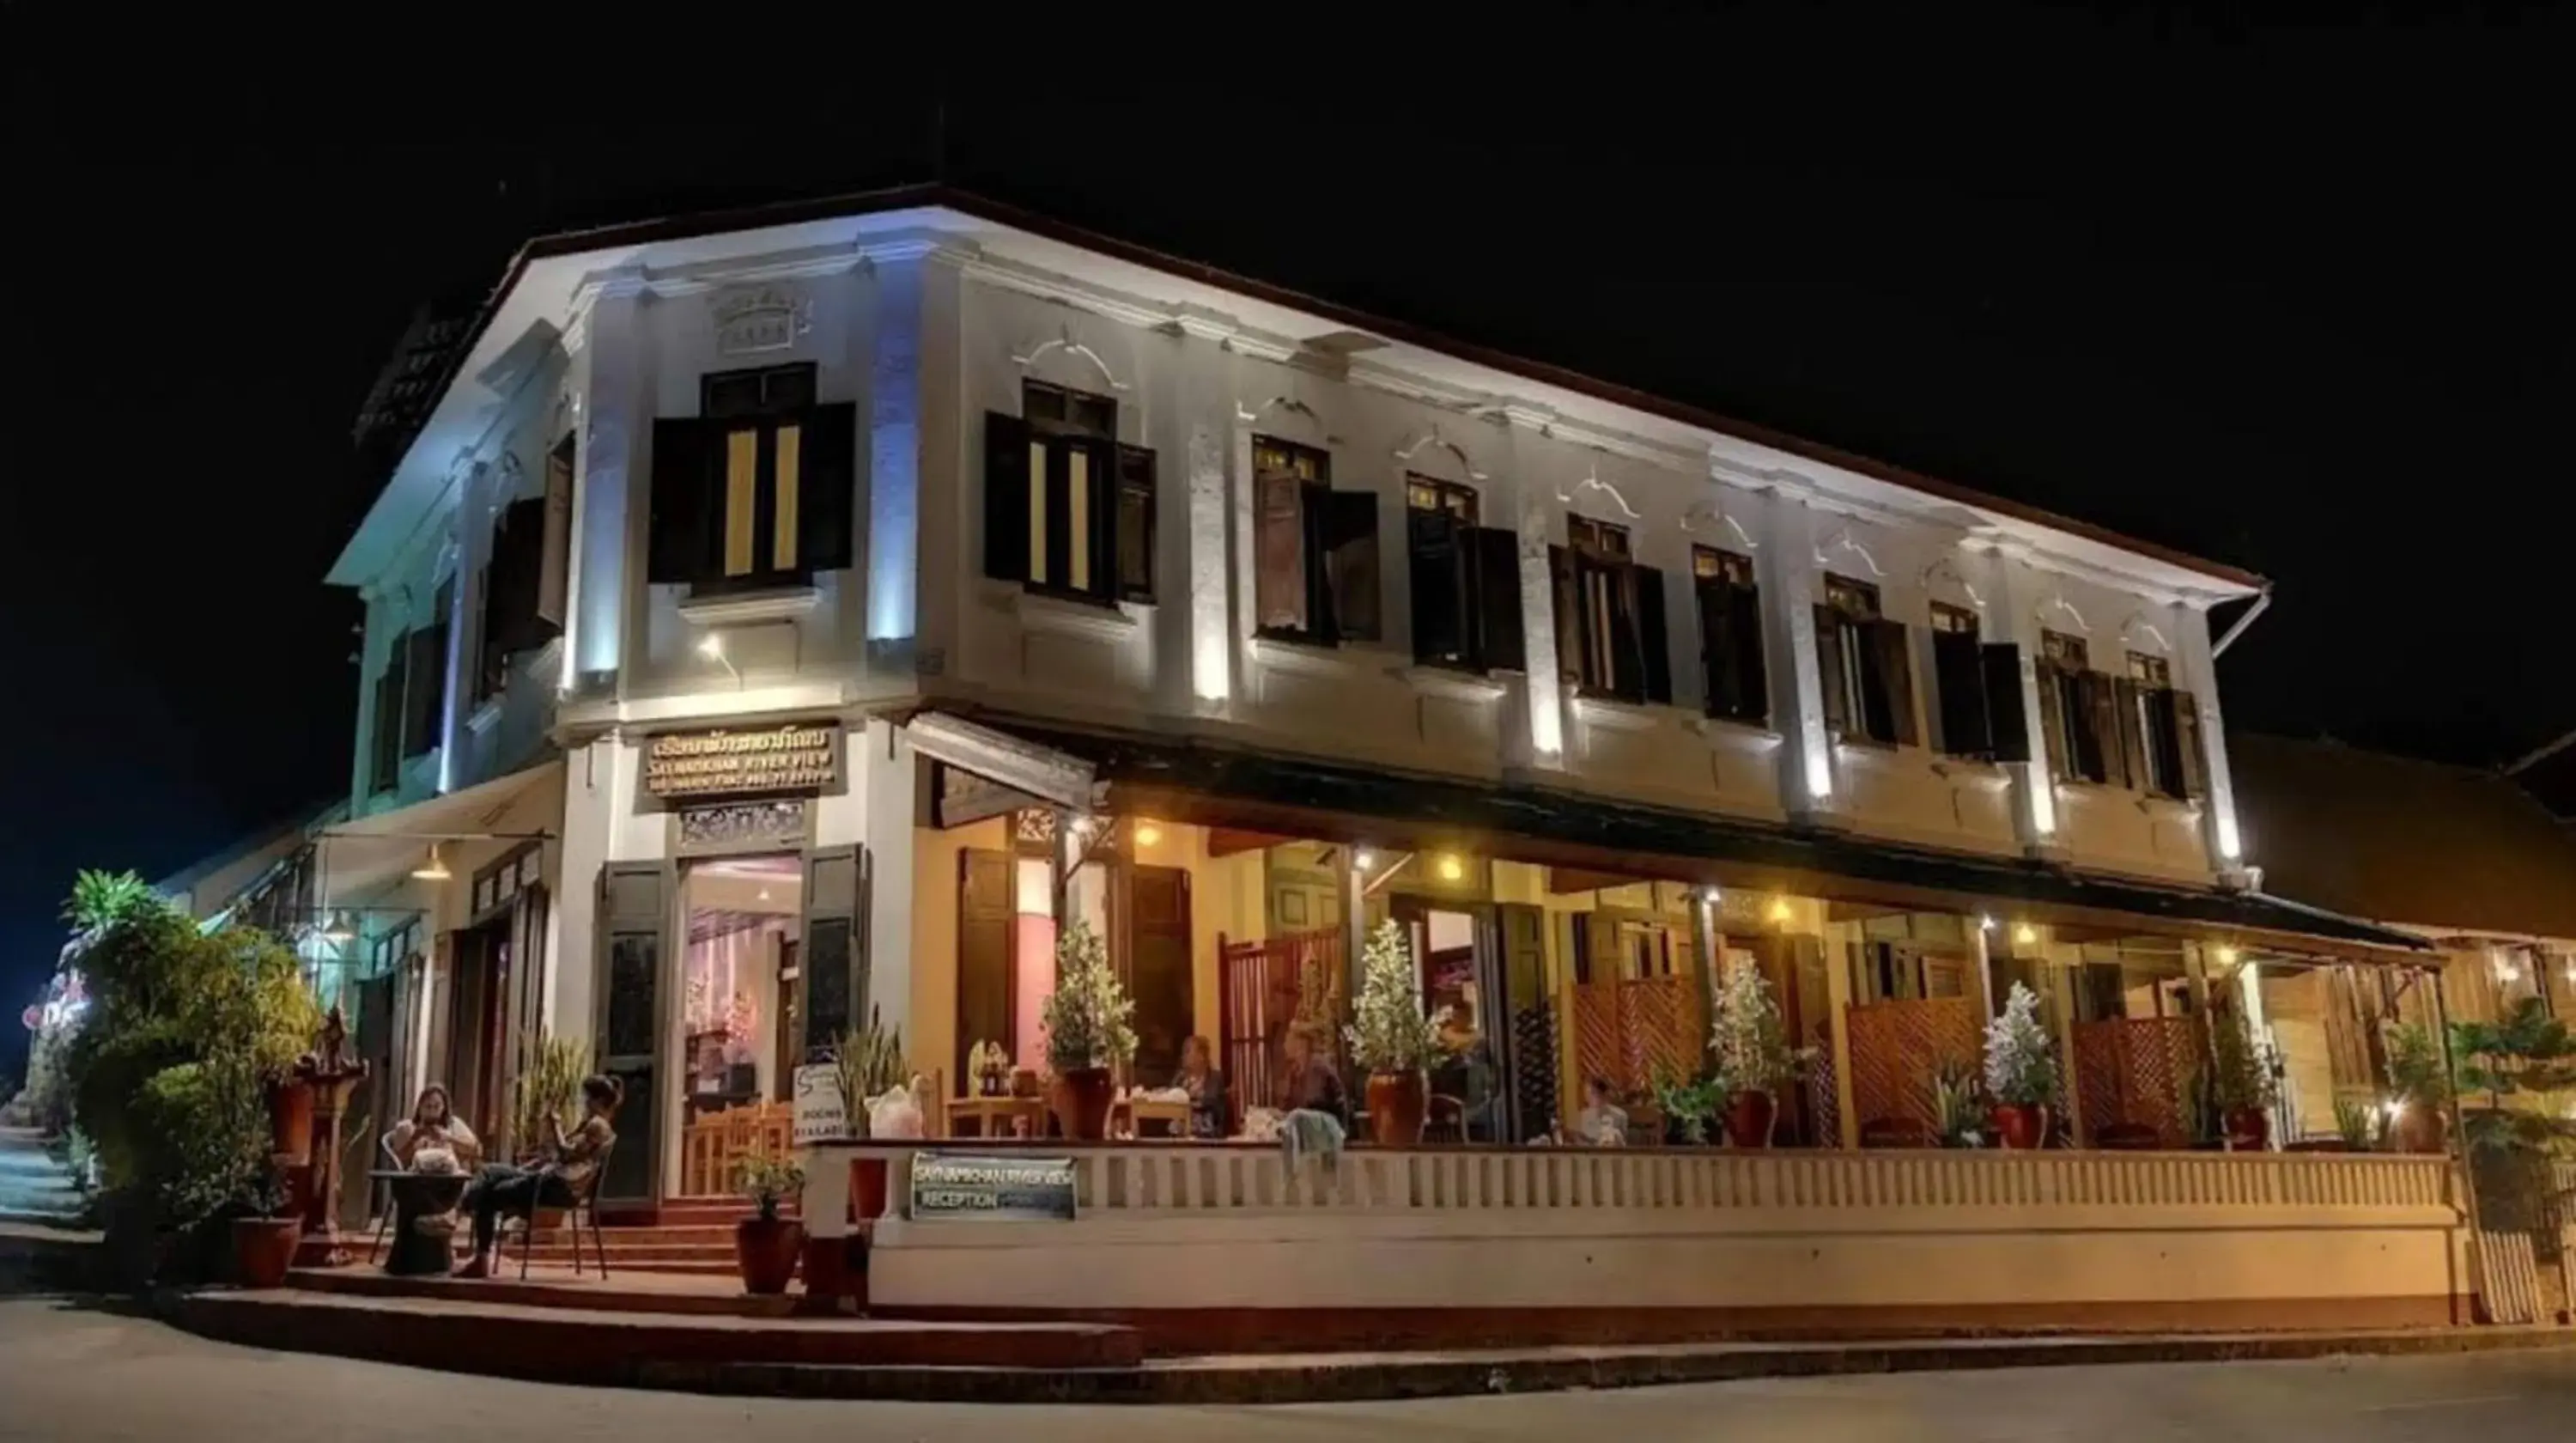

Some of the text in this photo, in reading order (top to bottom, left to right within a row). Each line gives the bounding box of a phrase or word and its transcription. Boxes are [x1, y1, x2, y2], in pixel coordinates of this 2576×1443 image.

[744, 753, 788, 770] RIVER
[792, 751, 833, 767] VIEW
[921, 1190, 999, 1209] RECEPTION
